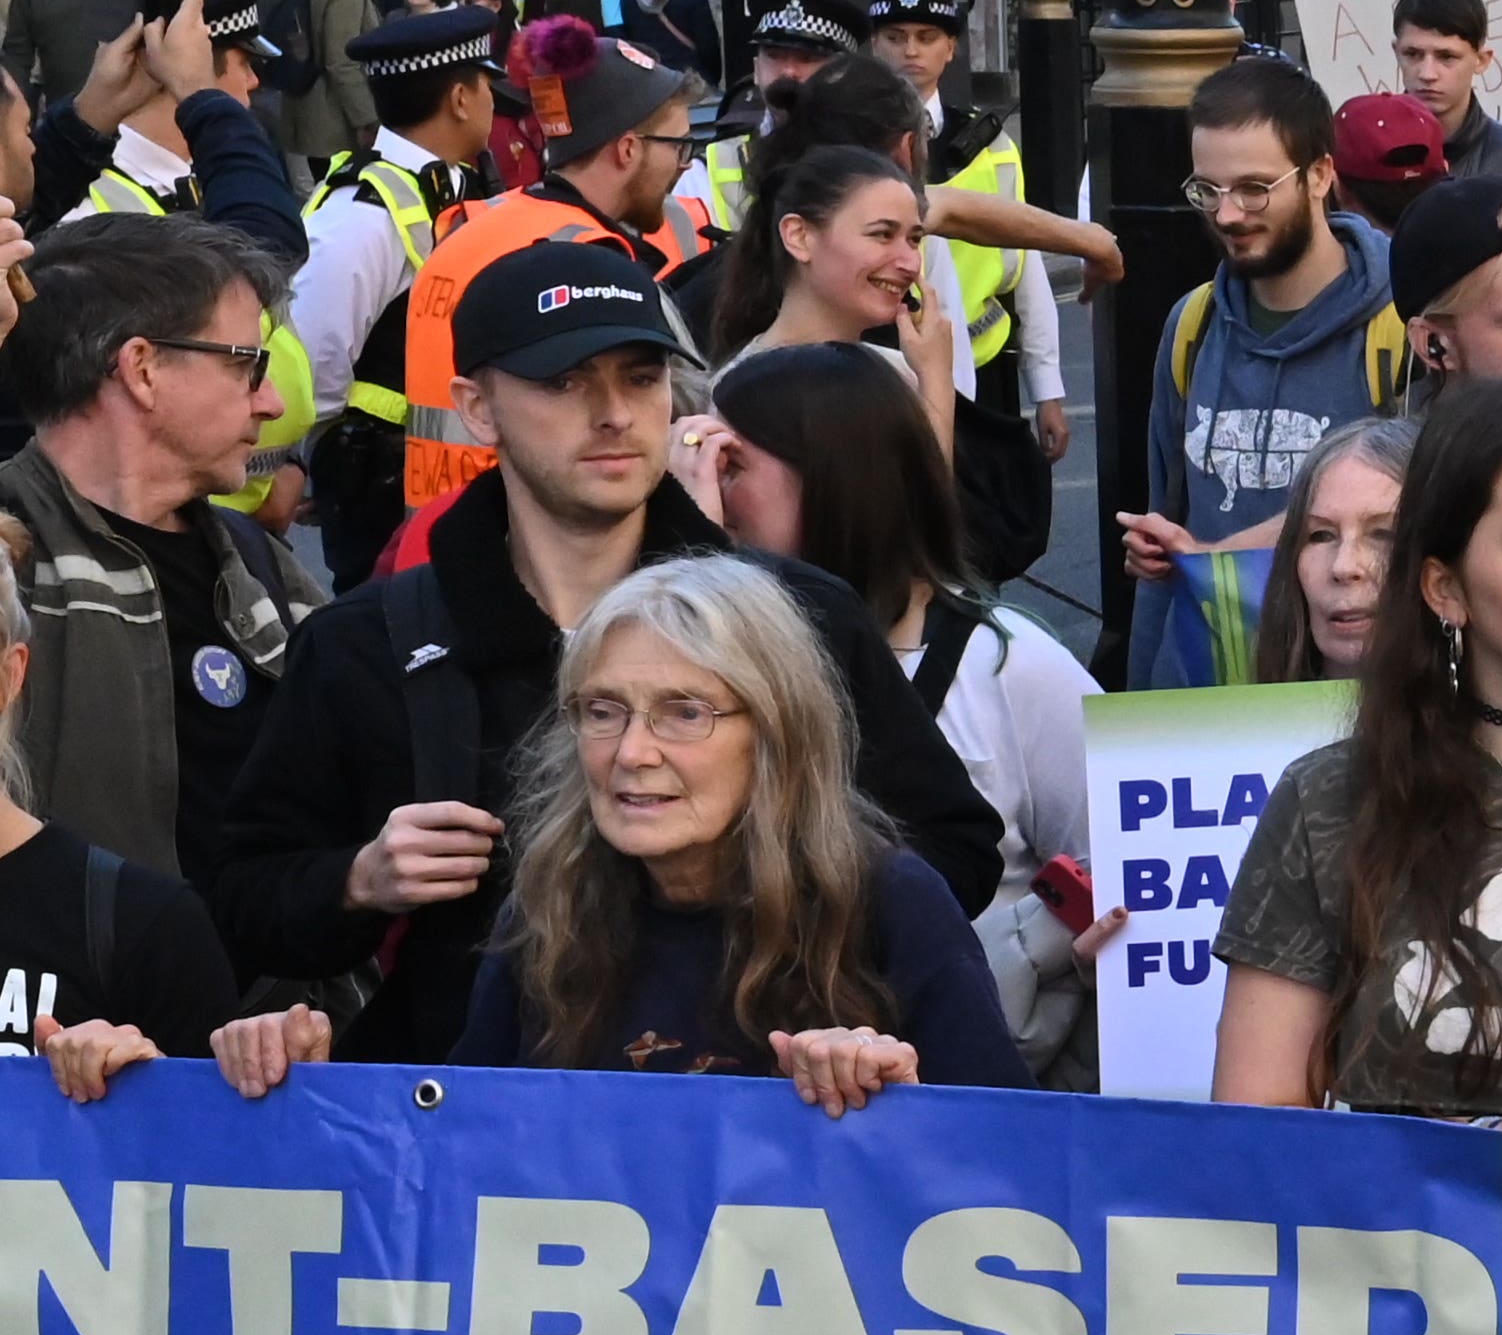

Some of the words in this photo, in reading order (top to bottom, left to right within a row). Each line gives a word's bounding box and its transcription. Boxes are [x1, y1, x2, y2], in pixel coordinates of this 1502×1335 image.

[1331, 3, 1374, 62] A
[571, 284, 644, 304] berghaus
[1119, 773, 1271, 832] PLA
